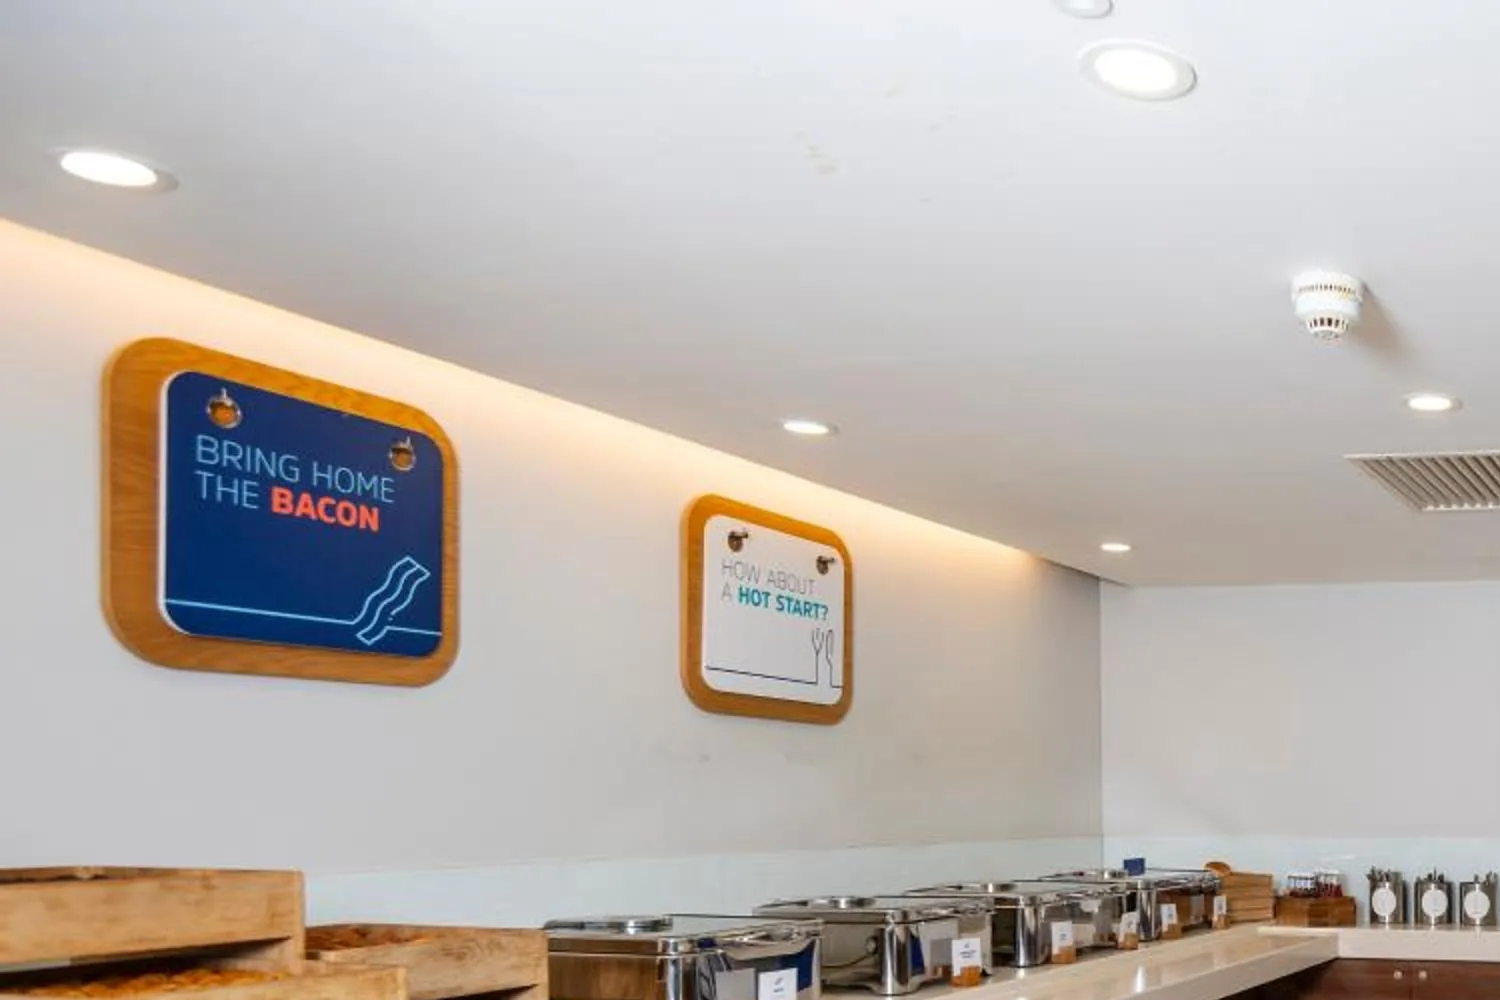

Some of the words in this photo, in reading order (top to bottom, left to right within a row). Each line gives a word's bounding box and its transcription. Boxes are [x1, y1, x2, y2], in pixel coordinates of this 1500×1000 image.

[195, 434, 299, 482] BRING
[312, 461, 396, 503] HOME
[195, 470, 260, 509] THE
[270, 486, 380, 532] BACON
[721, 558, 761, 584] HOW
[767, 570, 816, 596] ABOUT
[721, 583, 733, 601] A
[738, 586, 771, 608] HOT
[775, 594, 829, 622] START?
